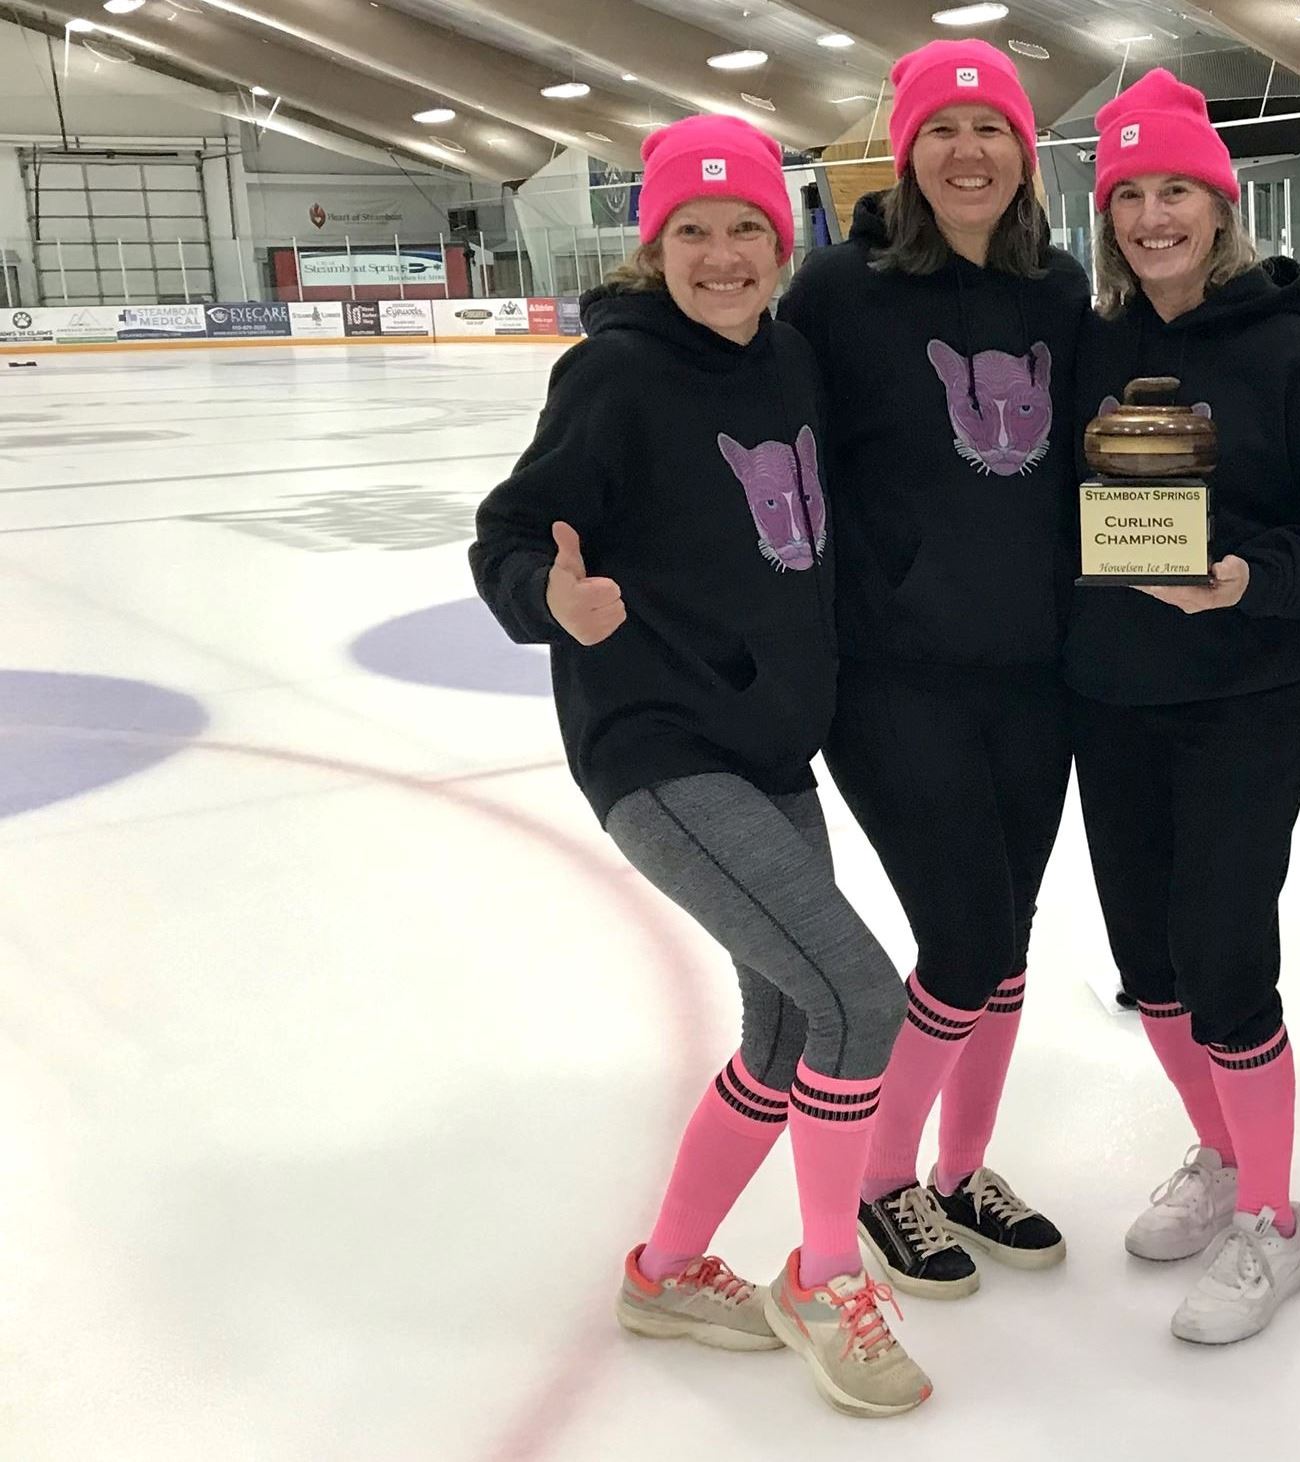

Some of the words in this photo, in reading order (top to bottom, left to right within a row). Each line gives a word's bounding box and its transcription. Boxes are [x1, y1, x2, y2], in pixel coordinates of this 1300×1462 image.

[138, 307, 200, 317] STEAMBOAT
[231, 307, 288, 319] EYECARE
[139, 315, 201, 326] MEDICAL
[1085, 490, 1150, 500] STEAMBOAT
[1152, 490, 1200, 501] SPRINGS
[1104, 516, 1174, 528] CURLING
[1094, 533, 1188, 545] CHAMPIONS
[1099, 562, 1144, 573] Howelsen
[1147, 562, 1160, 573] Ice
[1163, 563, 1190, 573] Arena
